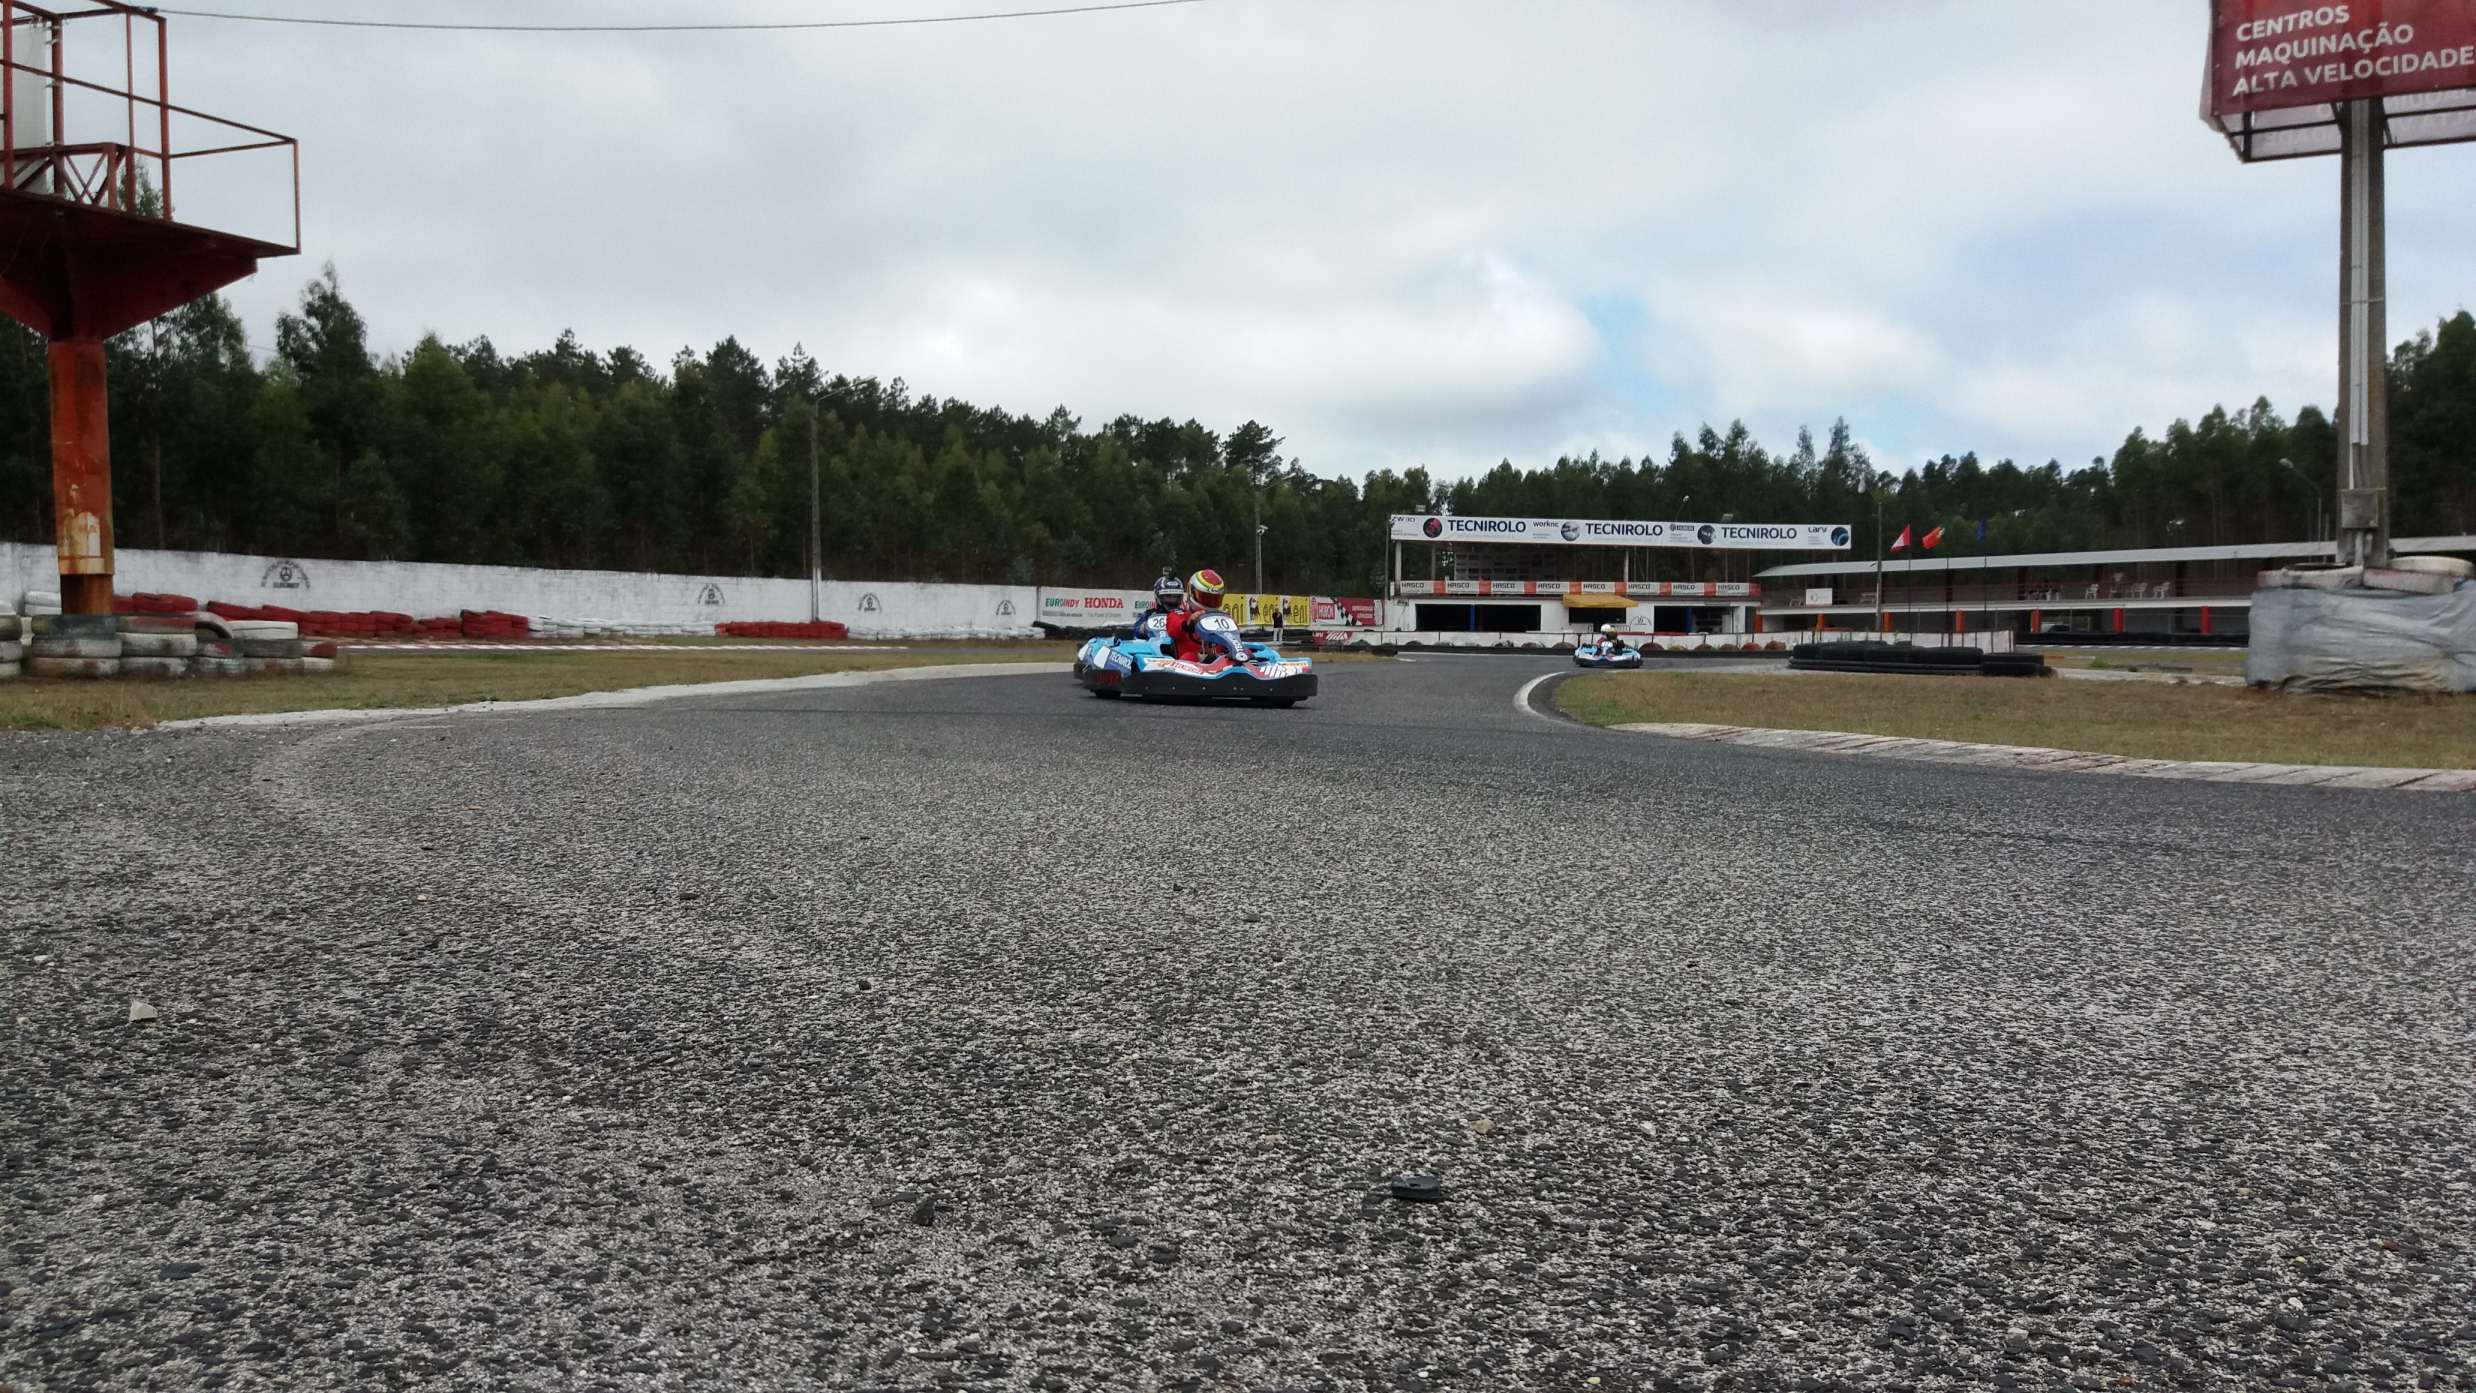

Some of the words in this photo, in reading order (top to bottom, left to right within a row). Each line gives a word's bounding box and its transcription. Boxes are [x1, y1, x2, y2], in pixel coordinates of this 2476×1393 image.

[2236, 5, 2350, 42] CENTROS
[2235, 22, 2414, 70] MAQUINAÇÃO
[2232, 70, 2299, 96] ALTA
[2304, 45, 2475, 85] VELOCIDADE
[1447, 519, 1527, 533] TECNIROLO
[1585, 523, 1663, 536] TECNIROLO
[1721, 527, 1797, 539] TECNIROLO
[1084, 597, 1124, 608] HONDA
[1153, 618, 1165, 628] 26
[1214, 618, 1229, 629] 10
